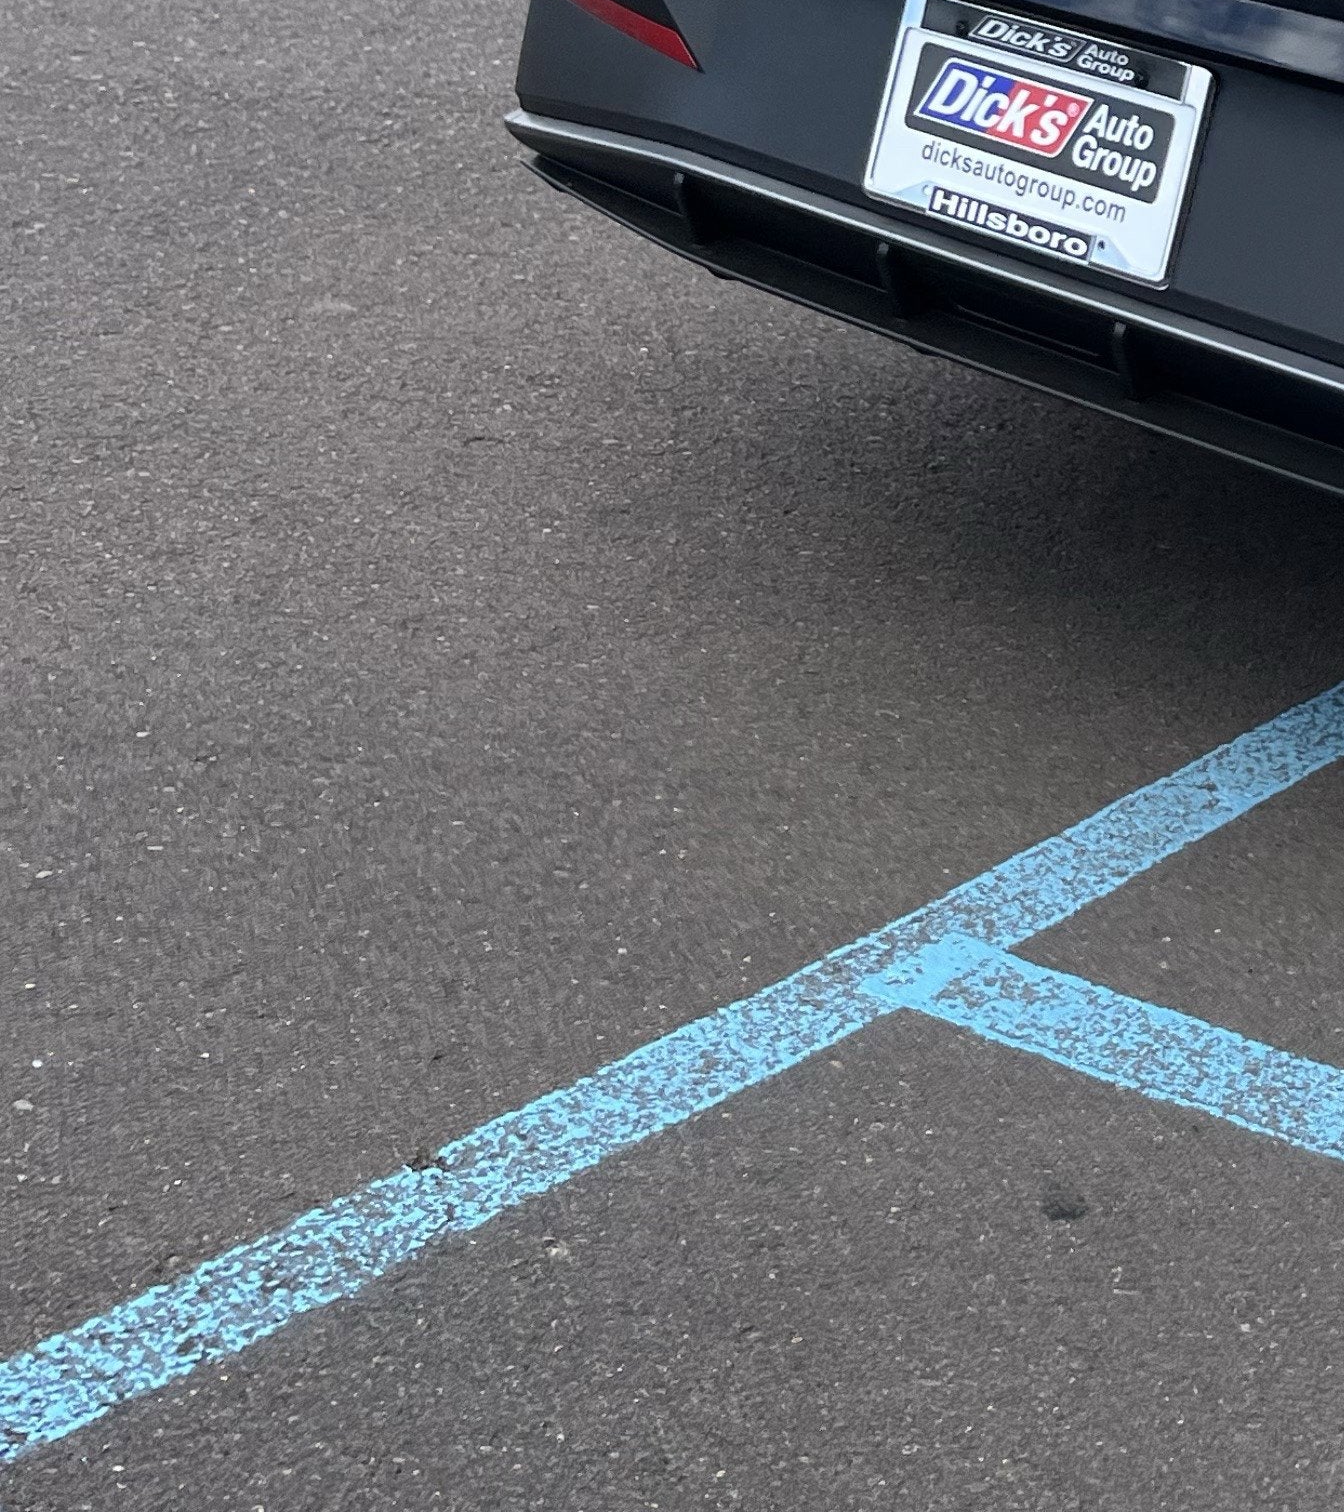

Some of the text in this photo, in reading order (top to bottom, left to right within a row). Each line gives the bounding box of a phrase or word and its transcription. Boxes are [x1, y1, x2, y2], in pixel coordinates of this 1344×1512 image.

[977, 19, 1073, 58] Dick's
[1084, 44, 1129, 66] Auto
[1076, 54, 1135, 82] Group
[927, 68, 1069, 146] Dick's
[1083, 103, 1155, 150] Auto
[922, 141, 1126, 223] dicksautogroup.com
[1071, 134, 1157, 191] Group
[931, 189, 1088, 257] Hillsboro
